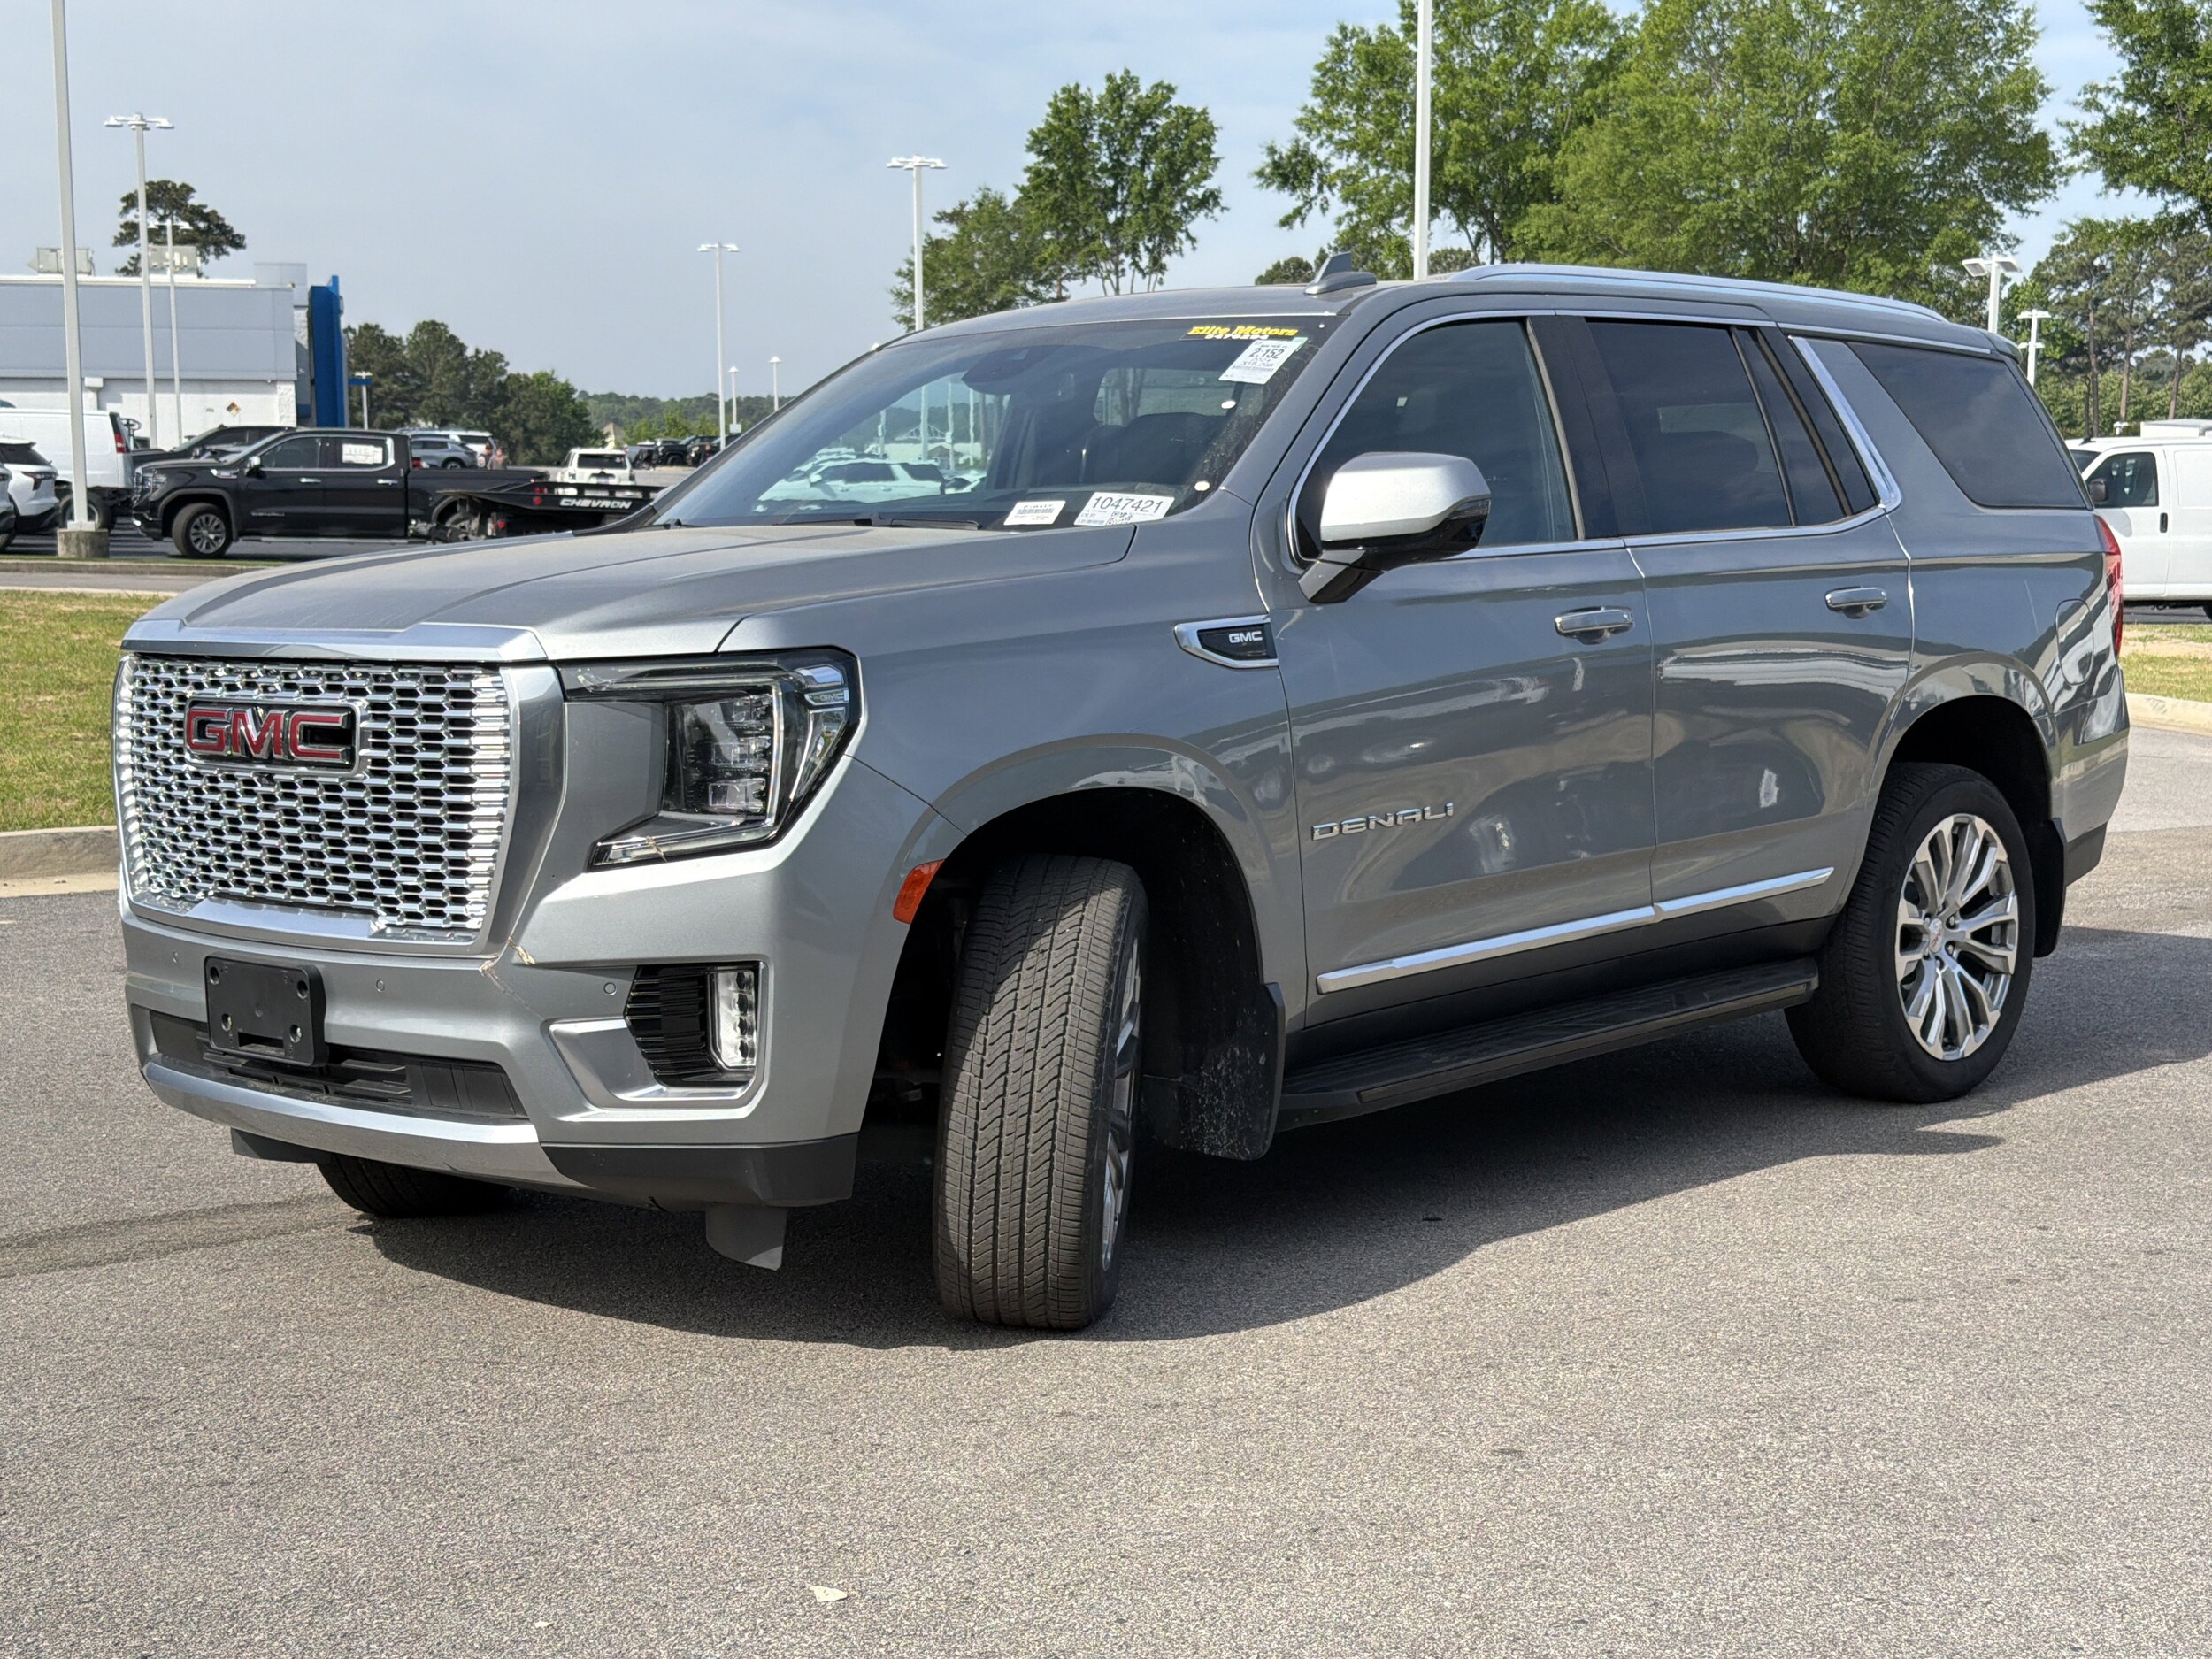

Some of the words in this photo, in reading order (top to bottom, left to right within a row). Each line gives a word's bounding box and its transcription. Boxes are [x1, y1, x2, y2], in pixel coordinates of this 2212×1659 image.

[1187, 326, 1230, 335] Elite
[1233, 326, 1298, 336] Motors
[559, 498, 633, 510] CHEVRON
[1094, 496, 1164, 513] 1047421
[1228, 630, 1263, 643] GMC
[186, 707, 346, 762] GMC
[1311, 802, 1454, 841] DENALI
